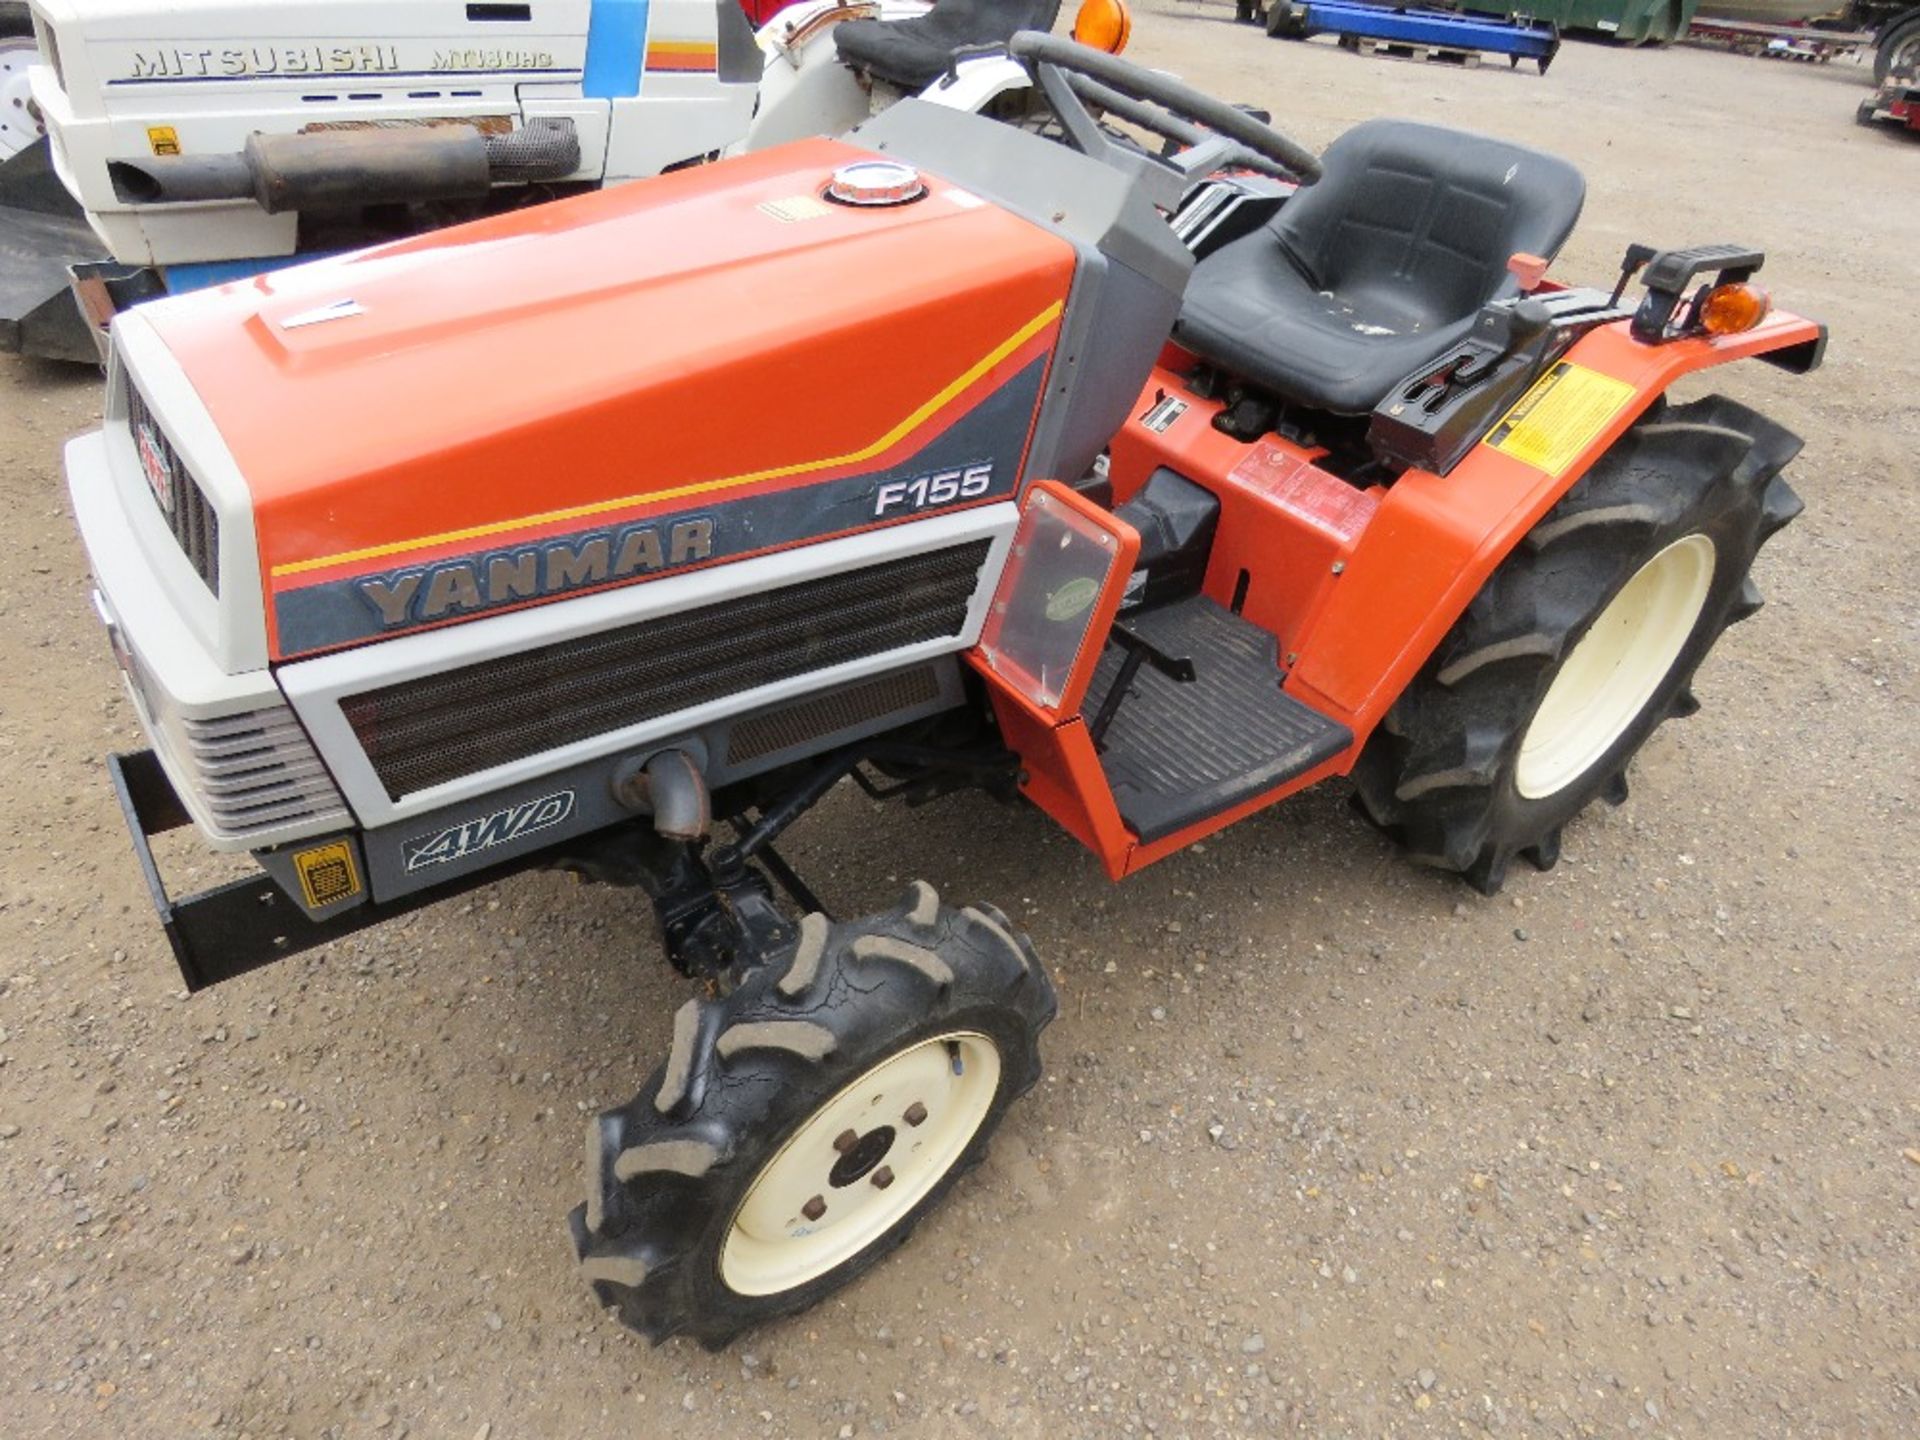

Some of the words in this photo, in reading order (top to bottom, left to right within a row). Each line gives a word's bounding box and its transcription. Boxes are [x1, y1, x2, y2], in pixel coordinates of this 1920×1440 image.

[131, 46, 399, 77] MITSUBISHI
[874, 464, 994, 516] F155
[360, 517, 714, 624] YANMAR
[407, 790, 575, 870] 4WD
